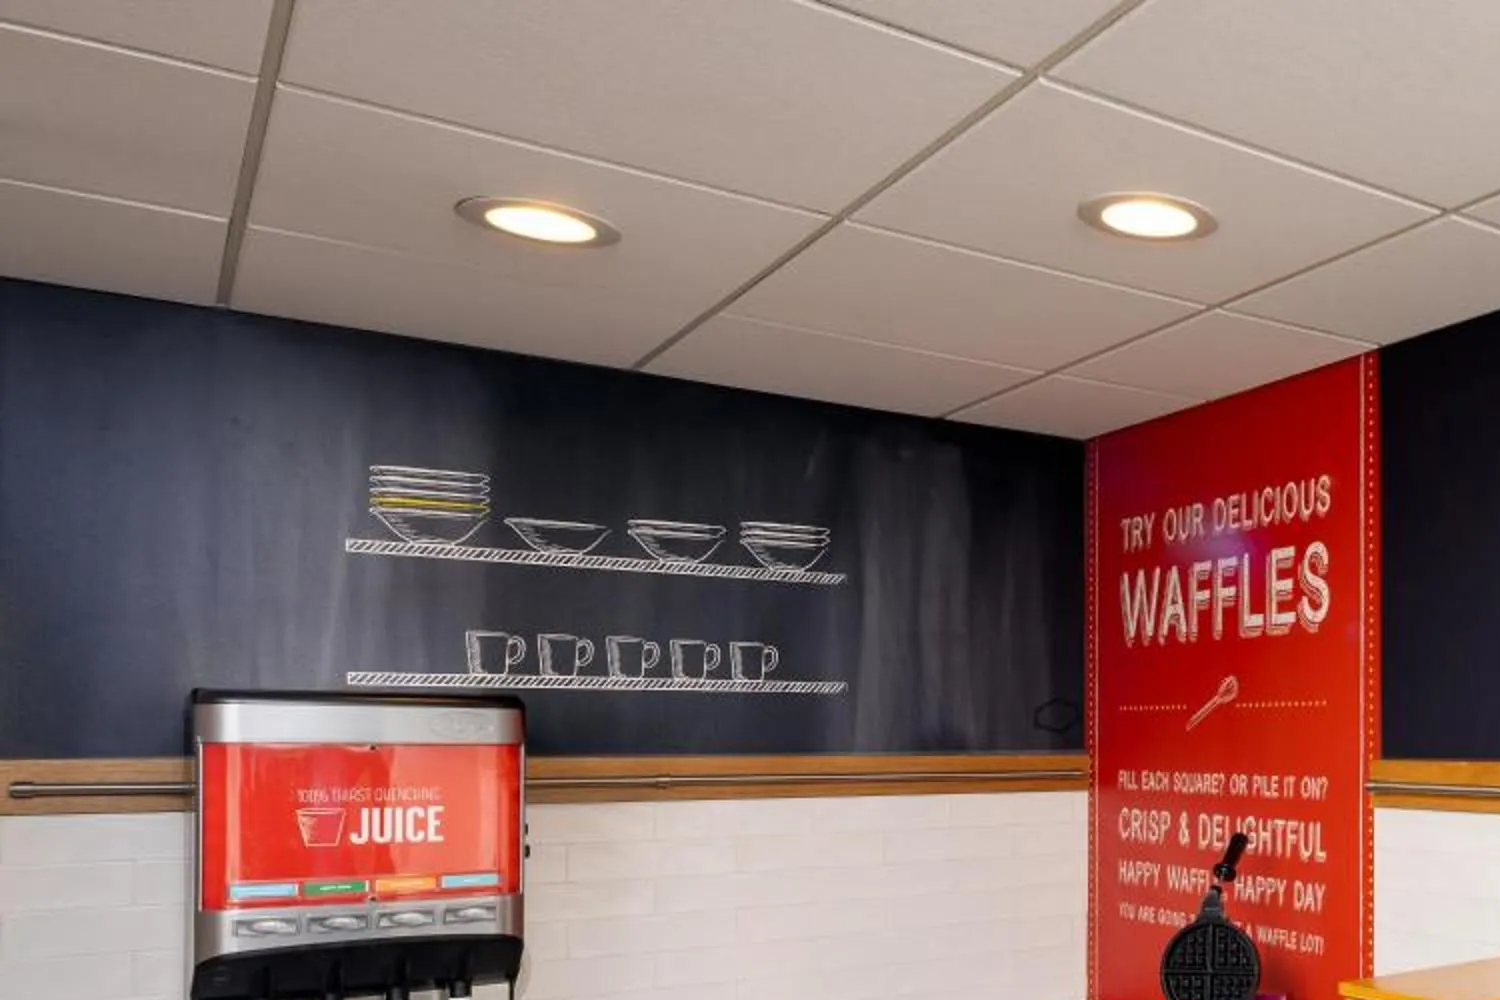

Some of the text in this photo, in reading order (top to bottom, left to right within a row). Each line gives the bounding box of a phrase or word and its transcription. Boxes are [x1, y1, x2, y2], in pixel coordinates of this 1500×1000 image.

[1120, 474, 1331, 552] TRY OUR DELICIOUS
[1120, 541, 1330, 648] WAFFLES
[1118, 769, 1328, 801] FILL EACH SQUARE? OR PILE IT ON?
[350, 805, 445, 844] JUICE
[1118, 806, 1171, 844] CRISP
[1179, 811, 1190, 846] &
[1119, 858, 1161, 887] HAPPY
[1234, 873, 1287, 907] HAPPY
[1294, 880, 1326, 914] DAY
[1119, 902, 1137, 919] YOU
[1138, 905, 1155, 924] ARE
[1257, 925, 1297, 950] WAFFLE
